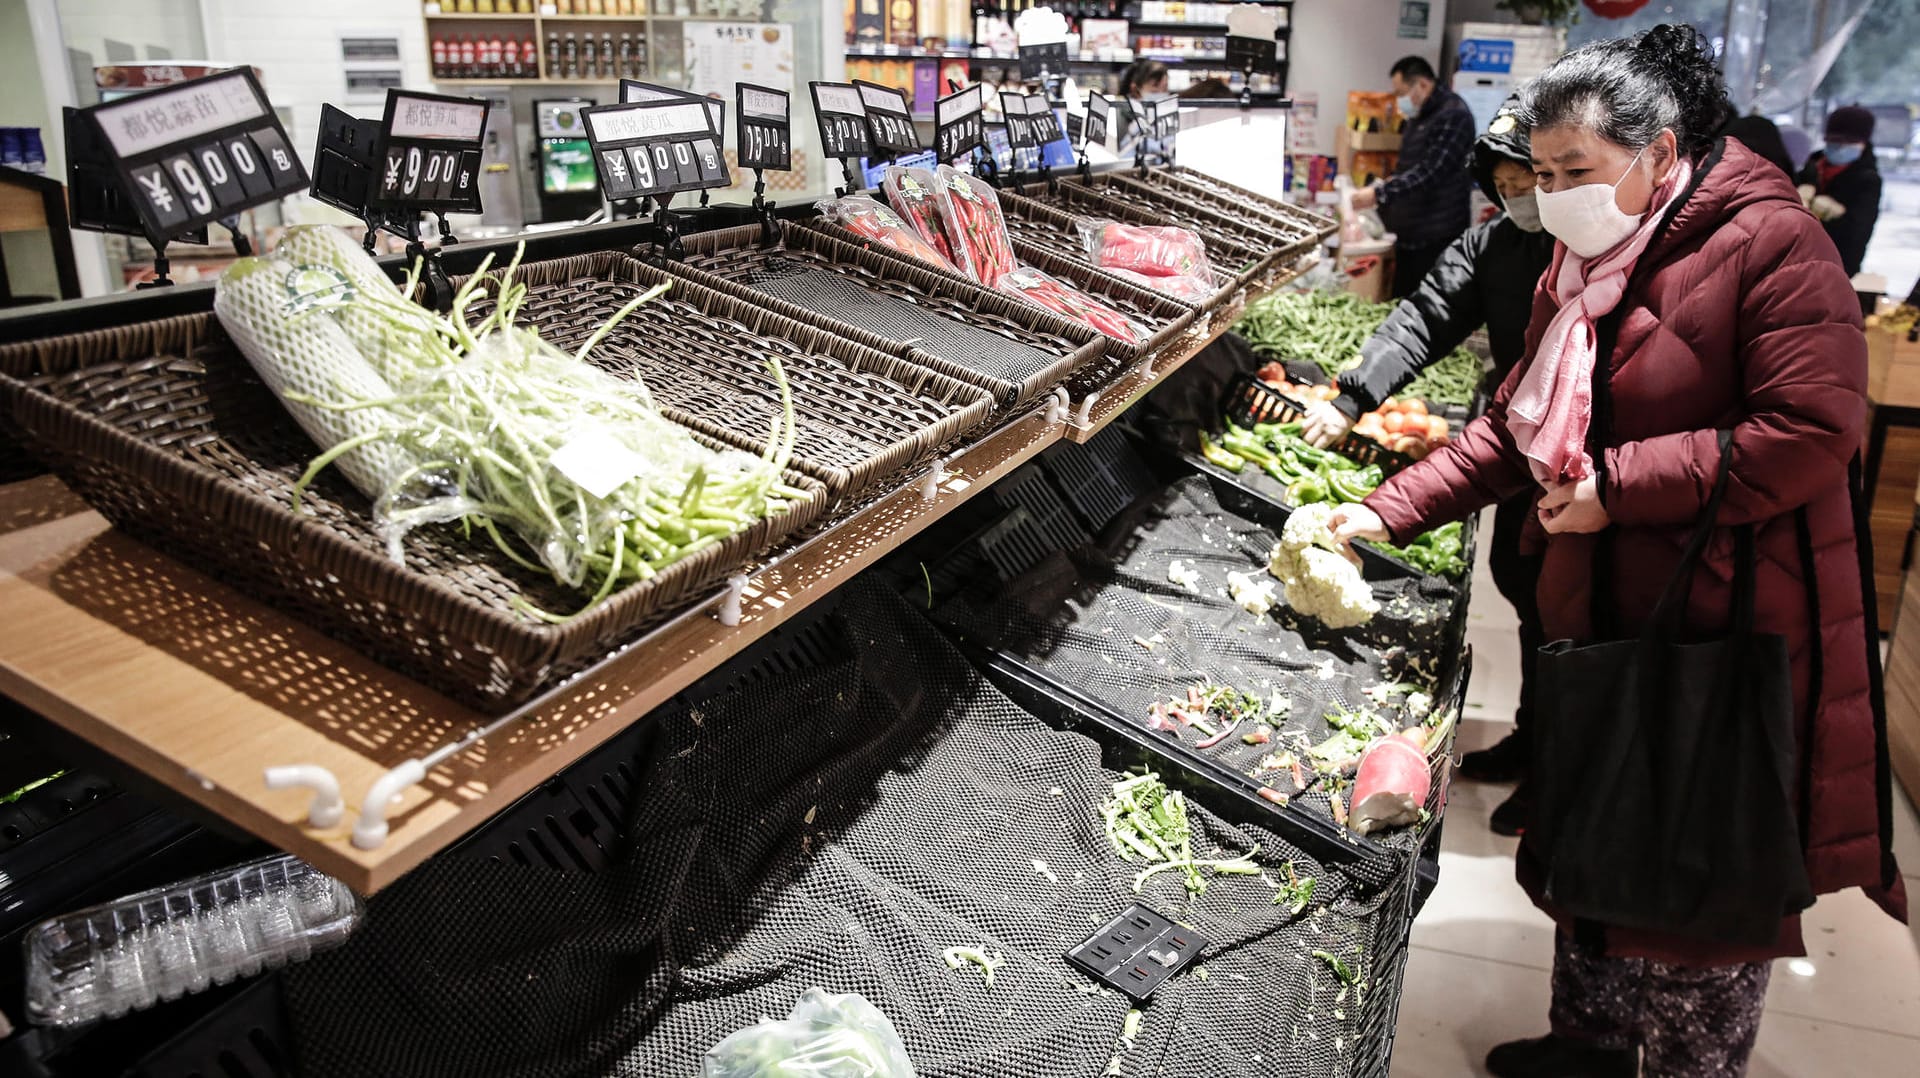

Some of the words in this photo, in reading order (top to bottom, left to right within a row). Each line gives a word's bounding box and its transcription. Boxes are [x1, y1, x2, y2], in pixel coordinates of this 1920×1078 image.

[139, 141, 256, 215] ¥9.00
[272, 148, 291, 172] 包
[385, 147, 455, 195] ¥9.00
[460, 170, 469, 188] 包
[607, 143, 690, 188] ¥9.00
[704, 153, 717, 169] 包
